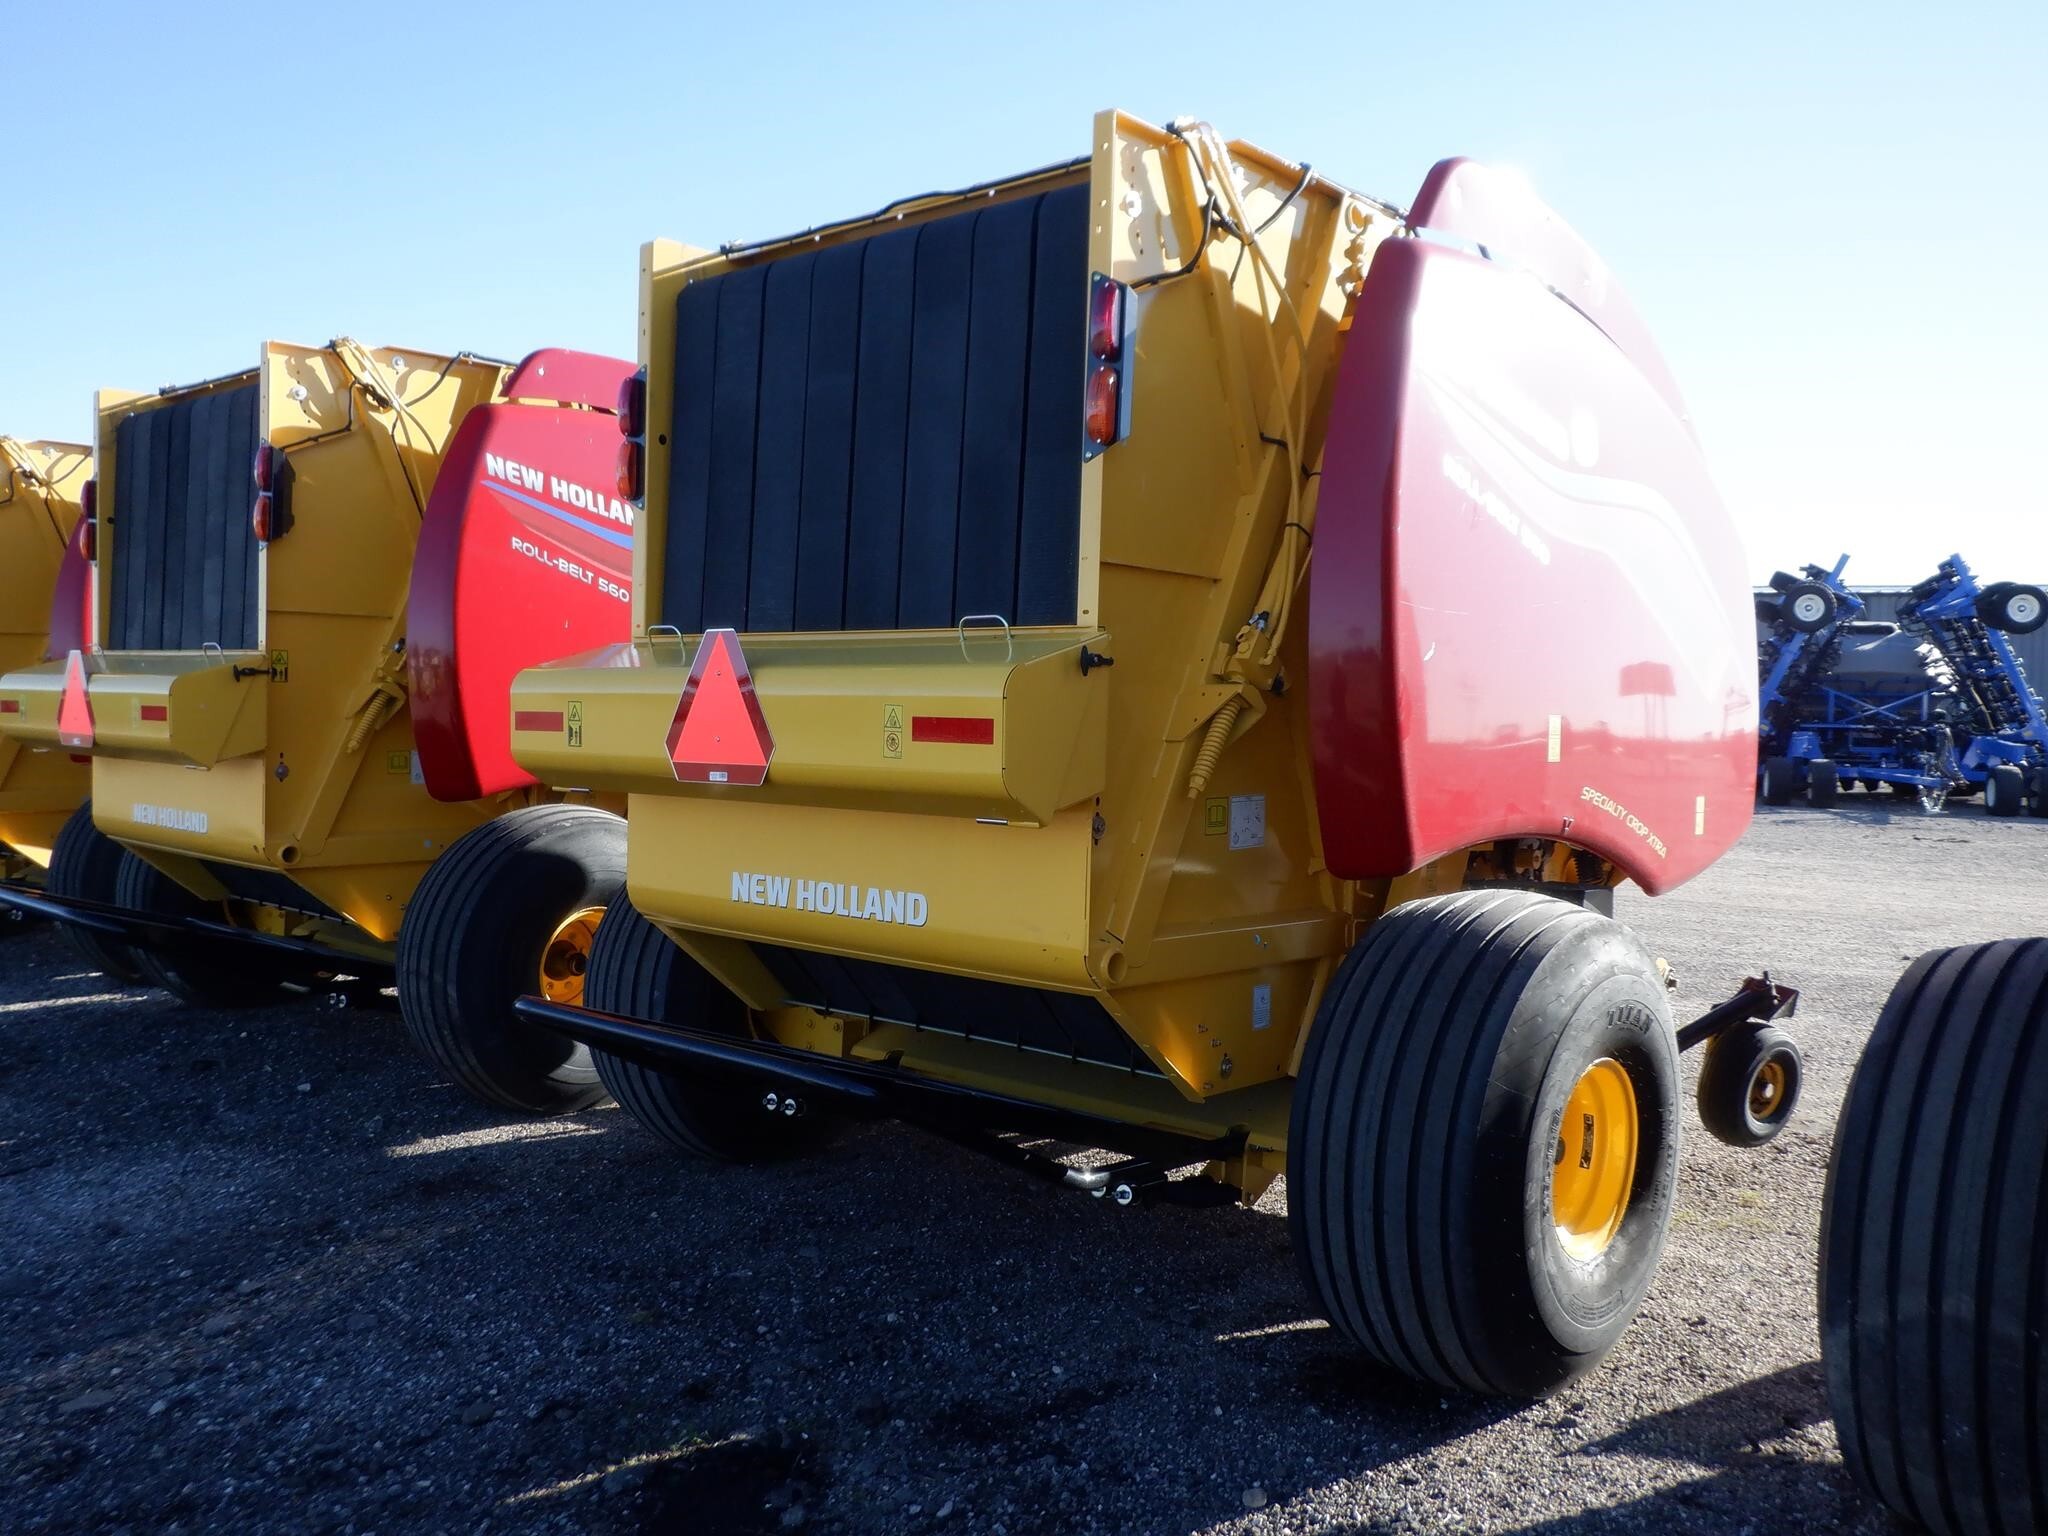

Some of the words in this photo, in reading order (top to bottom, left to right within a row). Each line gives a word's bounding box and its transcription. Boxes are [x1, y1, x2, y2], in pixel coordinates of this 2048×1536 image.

[485, 453, 543, 492] NEW
[551, 475, 634, 526] HOLLAN
[511, 536, 594, 584] ROLL-BELT
[598, 577, 629, 602] 560
[132, 803, 157, 825] NEW
[159, 808, 208, 834] HOLLAND
[1580, 786, 1627, 821] SPECIALTY
[1626, 814, 1648, 838] CROP
[1647, 833, 1667, 858] XTRA
[731, 871, 791, 908] NEW
[797, 879, 928, 927] HOLLAND
[1606, 1005, 1653, 1035] TITAN
